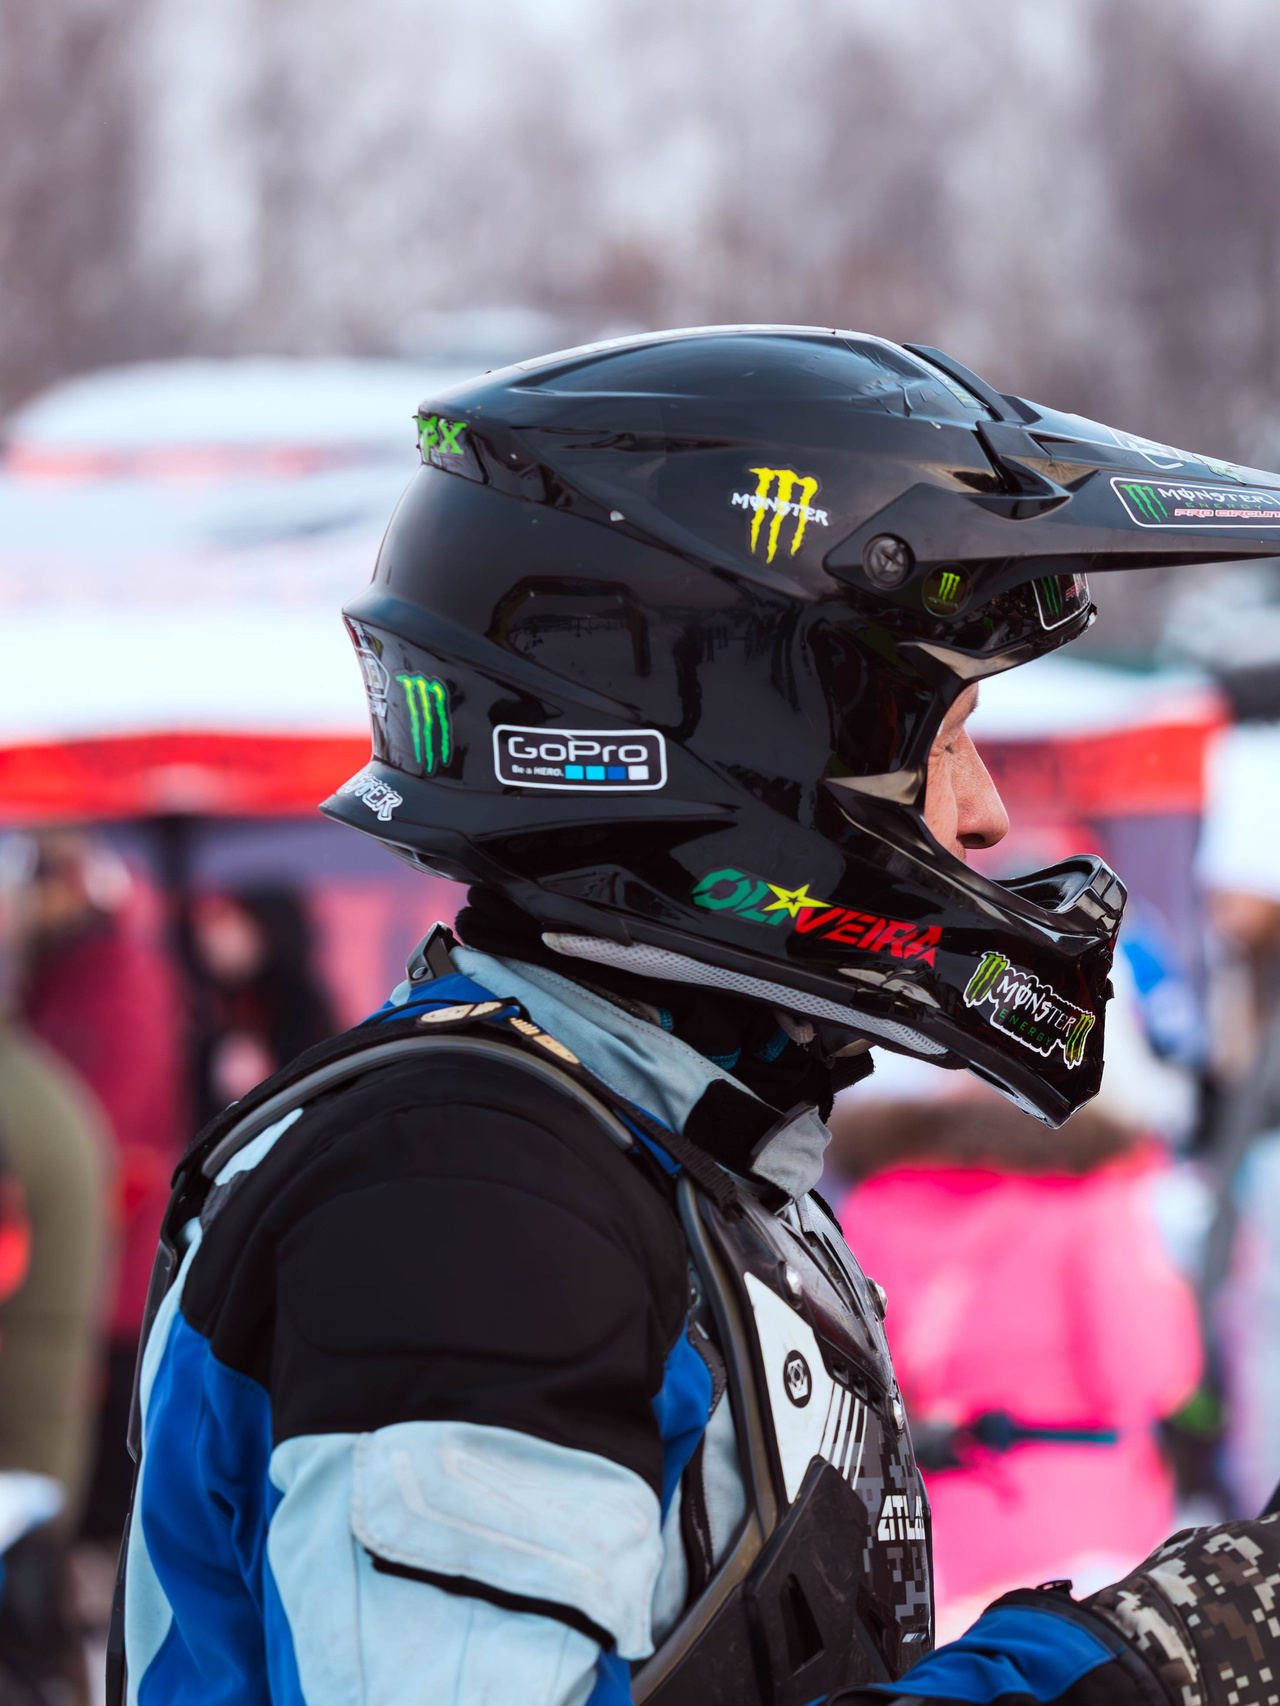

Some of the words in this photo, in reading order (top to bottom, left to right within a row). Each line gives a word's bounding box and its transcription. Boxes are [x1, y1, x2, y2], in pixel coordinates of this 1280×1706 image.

[1174, 508, 1214, 518] PRO
[508, 737, 648, 763] GoPro
[999, 1008, 1053, 1046] ENERGY
